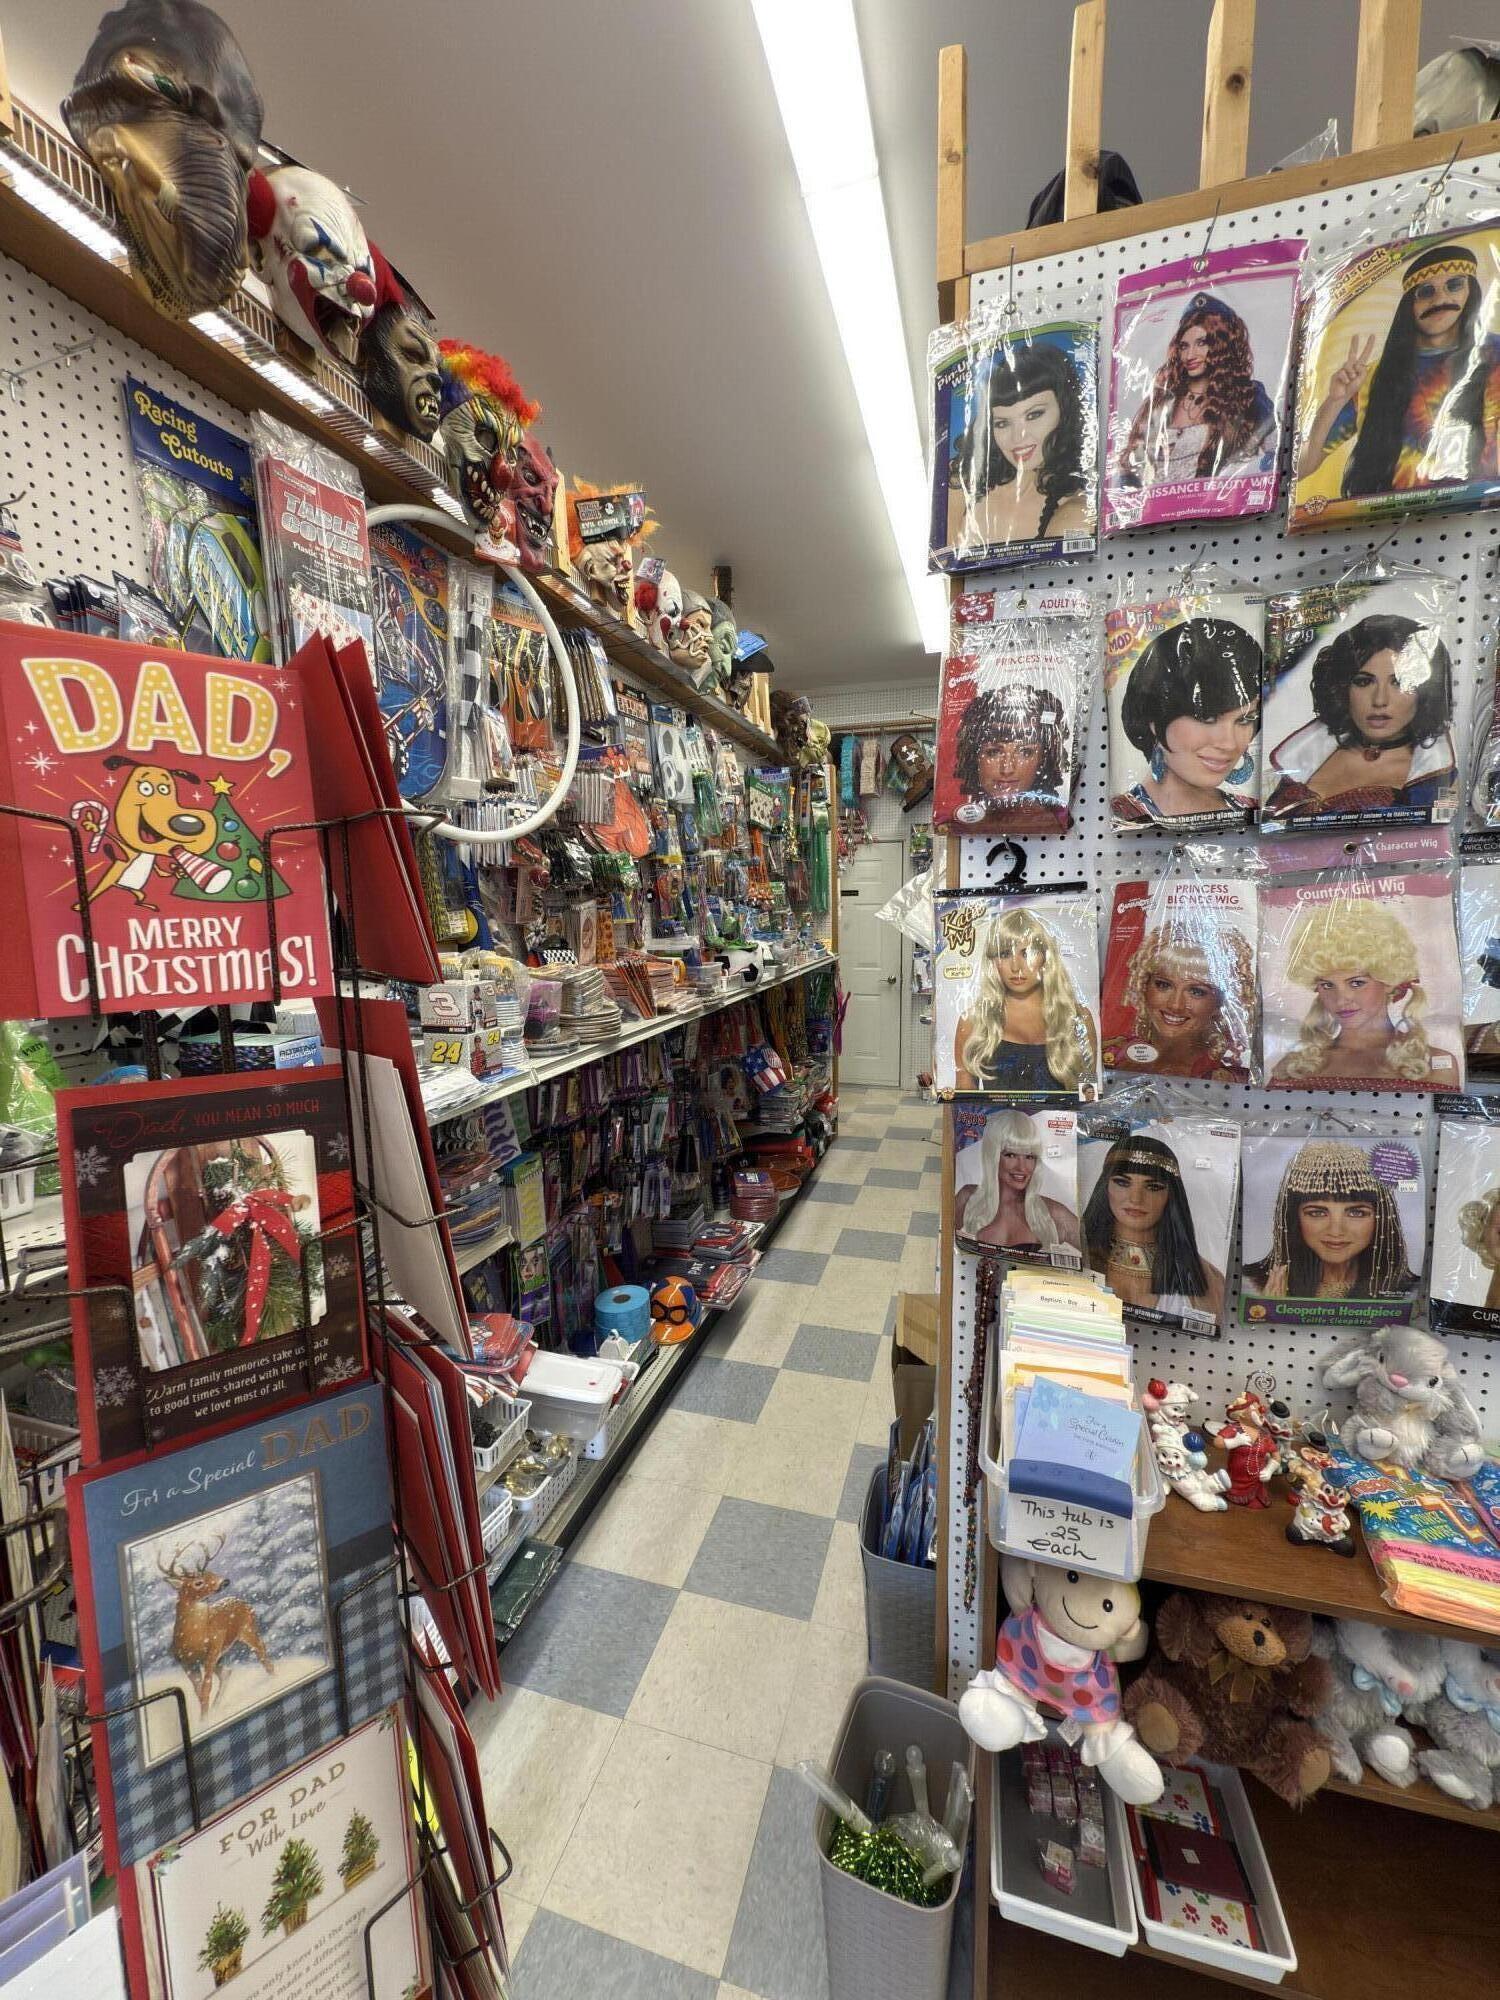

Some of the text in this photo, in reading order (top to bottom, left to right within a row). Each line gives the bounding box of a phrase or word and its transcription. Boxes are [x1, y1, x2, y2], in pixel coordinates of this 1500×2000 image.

[134, 391, 198, 443] Racing
[160, 432, 234, 481] Cutouts
[284, 490, 359, 541] TABLE
[281, 512, 364, 562] COVER
[1040, 599, 1068, 610] ADULT
[1109, 632, 1132, 653] MOD
[21, 657, 291, 778] DAD,
[1376, 838, 1438, 852] Character Wig
[1176, 884, 1229, 894] PRINCESS
[1215, 895, 1240, 905] WIG
[1296, 879, 1405, 901] Country Girl Wig
[128, 916, 243, 951] MERRY
[428, 992, 461, 1017] 3
[486, 1030, 500, 1046] 24
[431, 1041, 462, 1064] 24
[193, 1112, 220, 1126] YOU
[226, 1107, 261, 1125] MEAN
[266, 1103, 282, 1119] SO
[286, 1098, 320, 1115] MUCH
[1275, 1304, 1403, 1318] Cleopatra Headpiece
[145, 1383, 187, 1404] Warm
[189, 1368, 222, 1388] family
[224, 1357, 271, 1378] memories
[272, 1349, 294, 1362] take
[295, 1346, 306, 1356] us
[150, 1405, 162, 1417] to
[164, 1396, 190, 1415] good
[193, 1388, 222, 1404] times
[223, 1377, 257, 1393] shared
[259, 1368, 280, 1382] with
[281, 1361, 297, 1374] the
[194, 1405, 209, 1418] we
[211, 1398, 231, 1414] love
[234, 1389, 258, 1405] most
[260, 1383, 271, 1396] of
[120, 1488, 159, 1517] For
[182, 1449, 256, 1495] Special
[260, 1403, 372, 1471] DAD
[1021, 1500, 1115, 1529] This tub is
[1045, 1526, 1081, 1541] .25
[1027, 1538, 1097, 1561] each
[218, 1761, 347, 1855] FOR DAD
[247, 1801, 327, 1859] With Love
